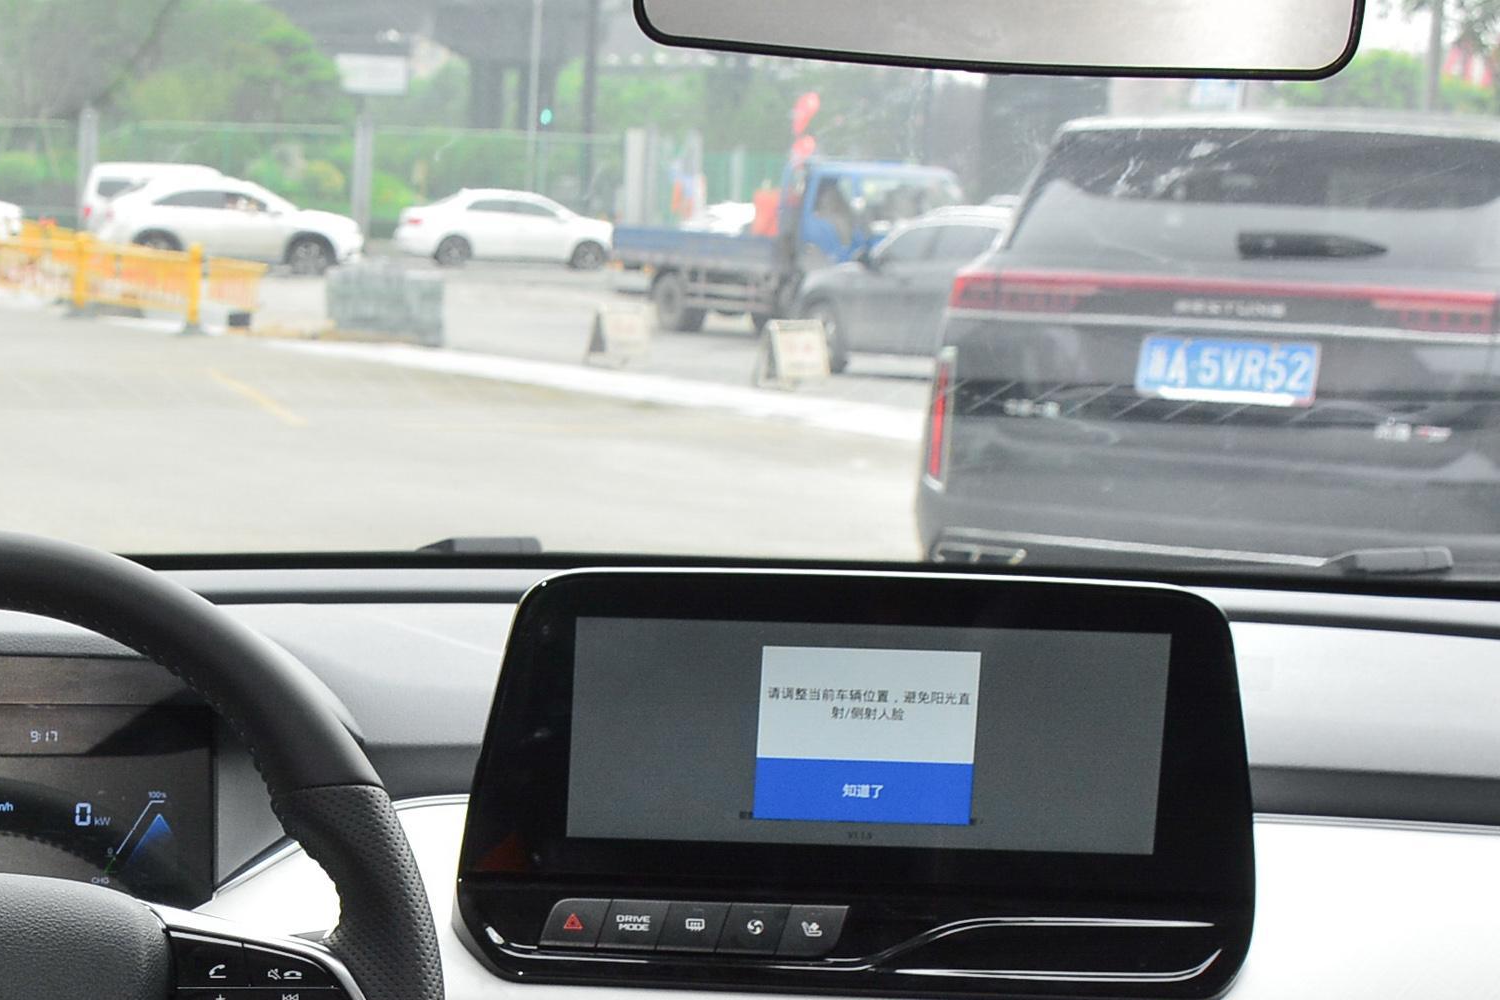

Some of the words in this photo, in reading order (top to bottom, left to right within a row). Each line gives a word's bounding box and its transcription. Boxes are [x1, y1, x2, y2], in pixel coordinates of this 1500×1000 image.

[841, 783, 885, 799] 知道了
[616, 914, 651, 924] DRIVE
[618, 922, 650, 932] MODE
